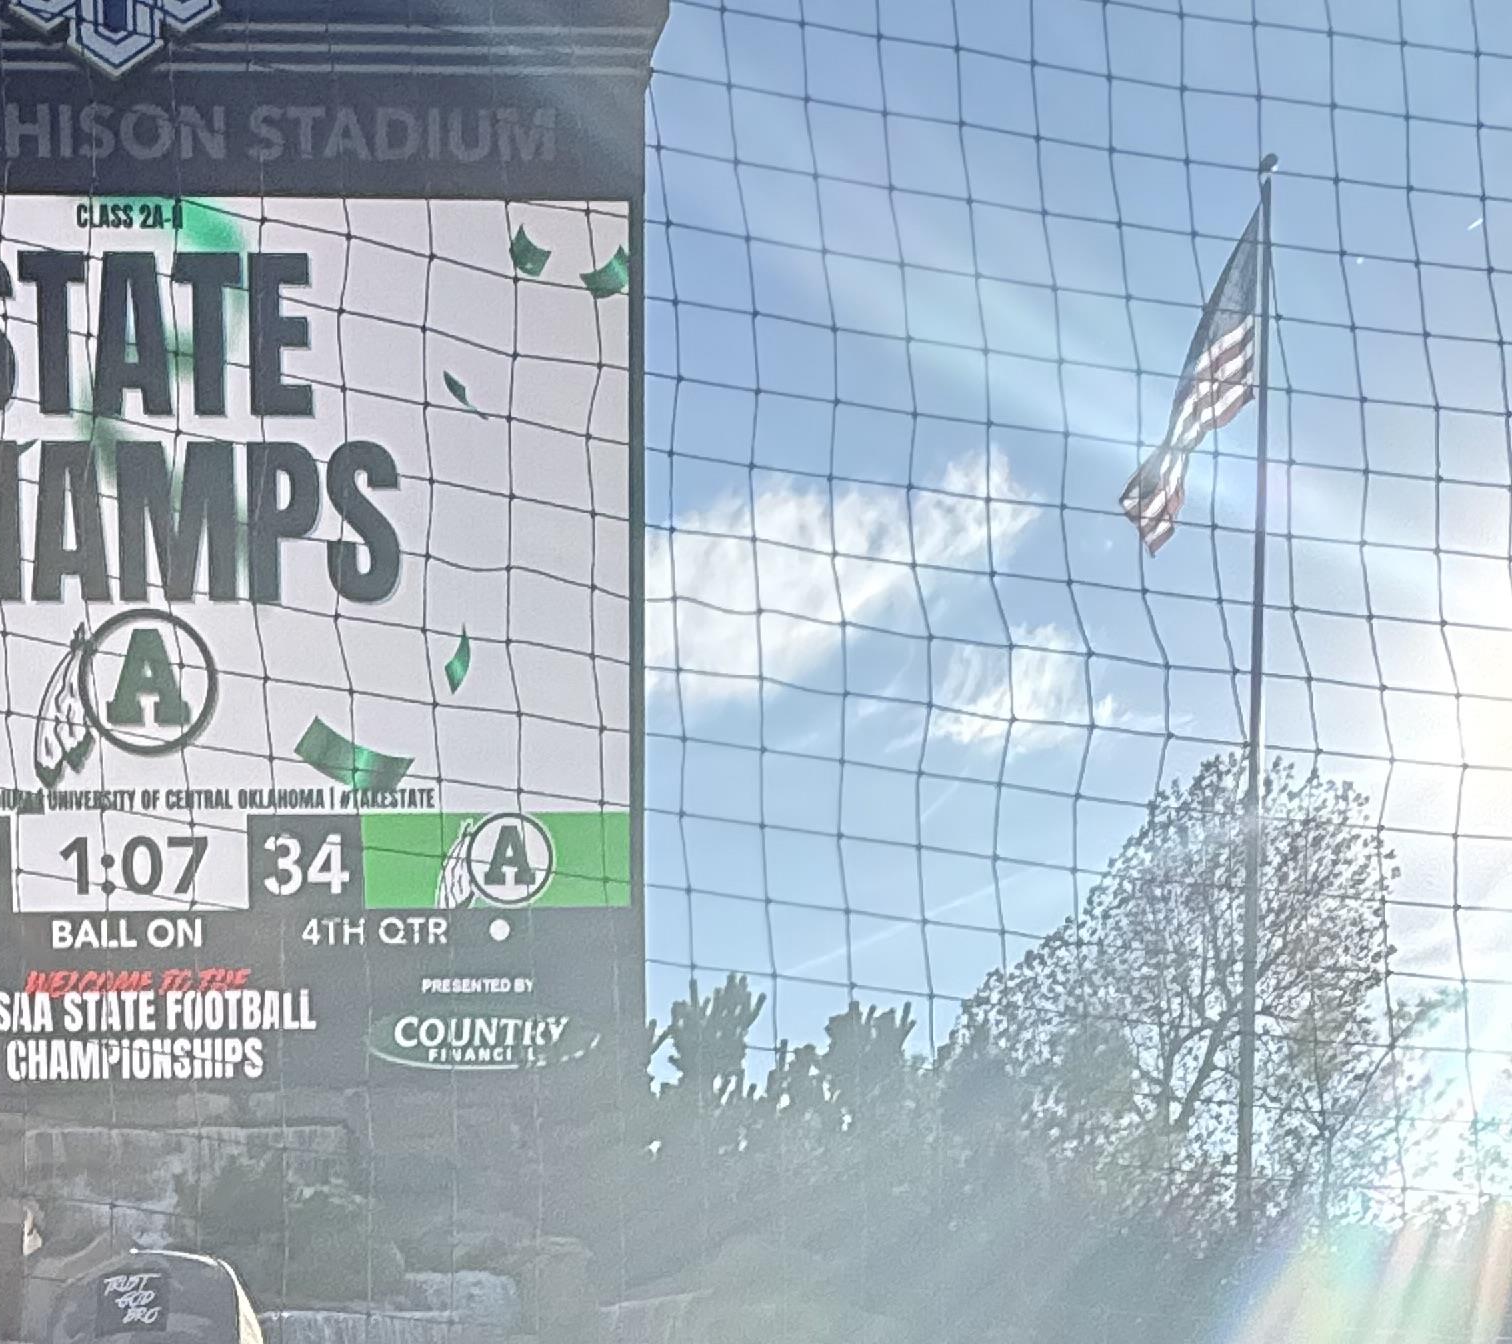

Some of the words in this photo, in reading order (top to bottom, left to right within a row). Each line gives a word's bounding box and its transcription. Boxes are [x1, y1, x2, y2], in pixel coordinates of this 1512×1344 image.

[248, 103, 556, 162] STADIUM
[76, 203, 133, 229] CLASS
[106, 627, 191, 726] A
[47, 789, 136, 811] UNIVERSITY
[141, 789, 159, 810] OF
[165, 789, 233, 810] CENTRAL
[238, 789, 326, 810] OKLAHOMA
[340, 788, 435, 810] #TAKESTATE
[59, 834, 209, 896] 1:07
[263, 832, 350, 897] 34
[483, 824, 537, 886] A
[51, 919, 136, 949] BALL
[147, 918, 202, 948] ON
[301, 918, 365, 947] 4TH
[378, 917, 448, 947] QTR
[421, 978, 511, 994] PRESENTED
[514, 977, 534, 994] BY
[63, 989, 156, 1032] STATE
[166, 988, 317, 1031] FOOTBALL
[394, 1015, 569, 1048] COUNTRY
[6, 1037, 264, 1081] CHAMPIONSHIPS
[428, 1047, 537, 1062] FINANCIL
[114, 1289, 156, 1308] GOD
[122, 1306, 163, 1324] BRO
